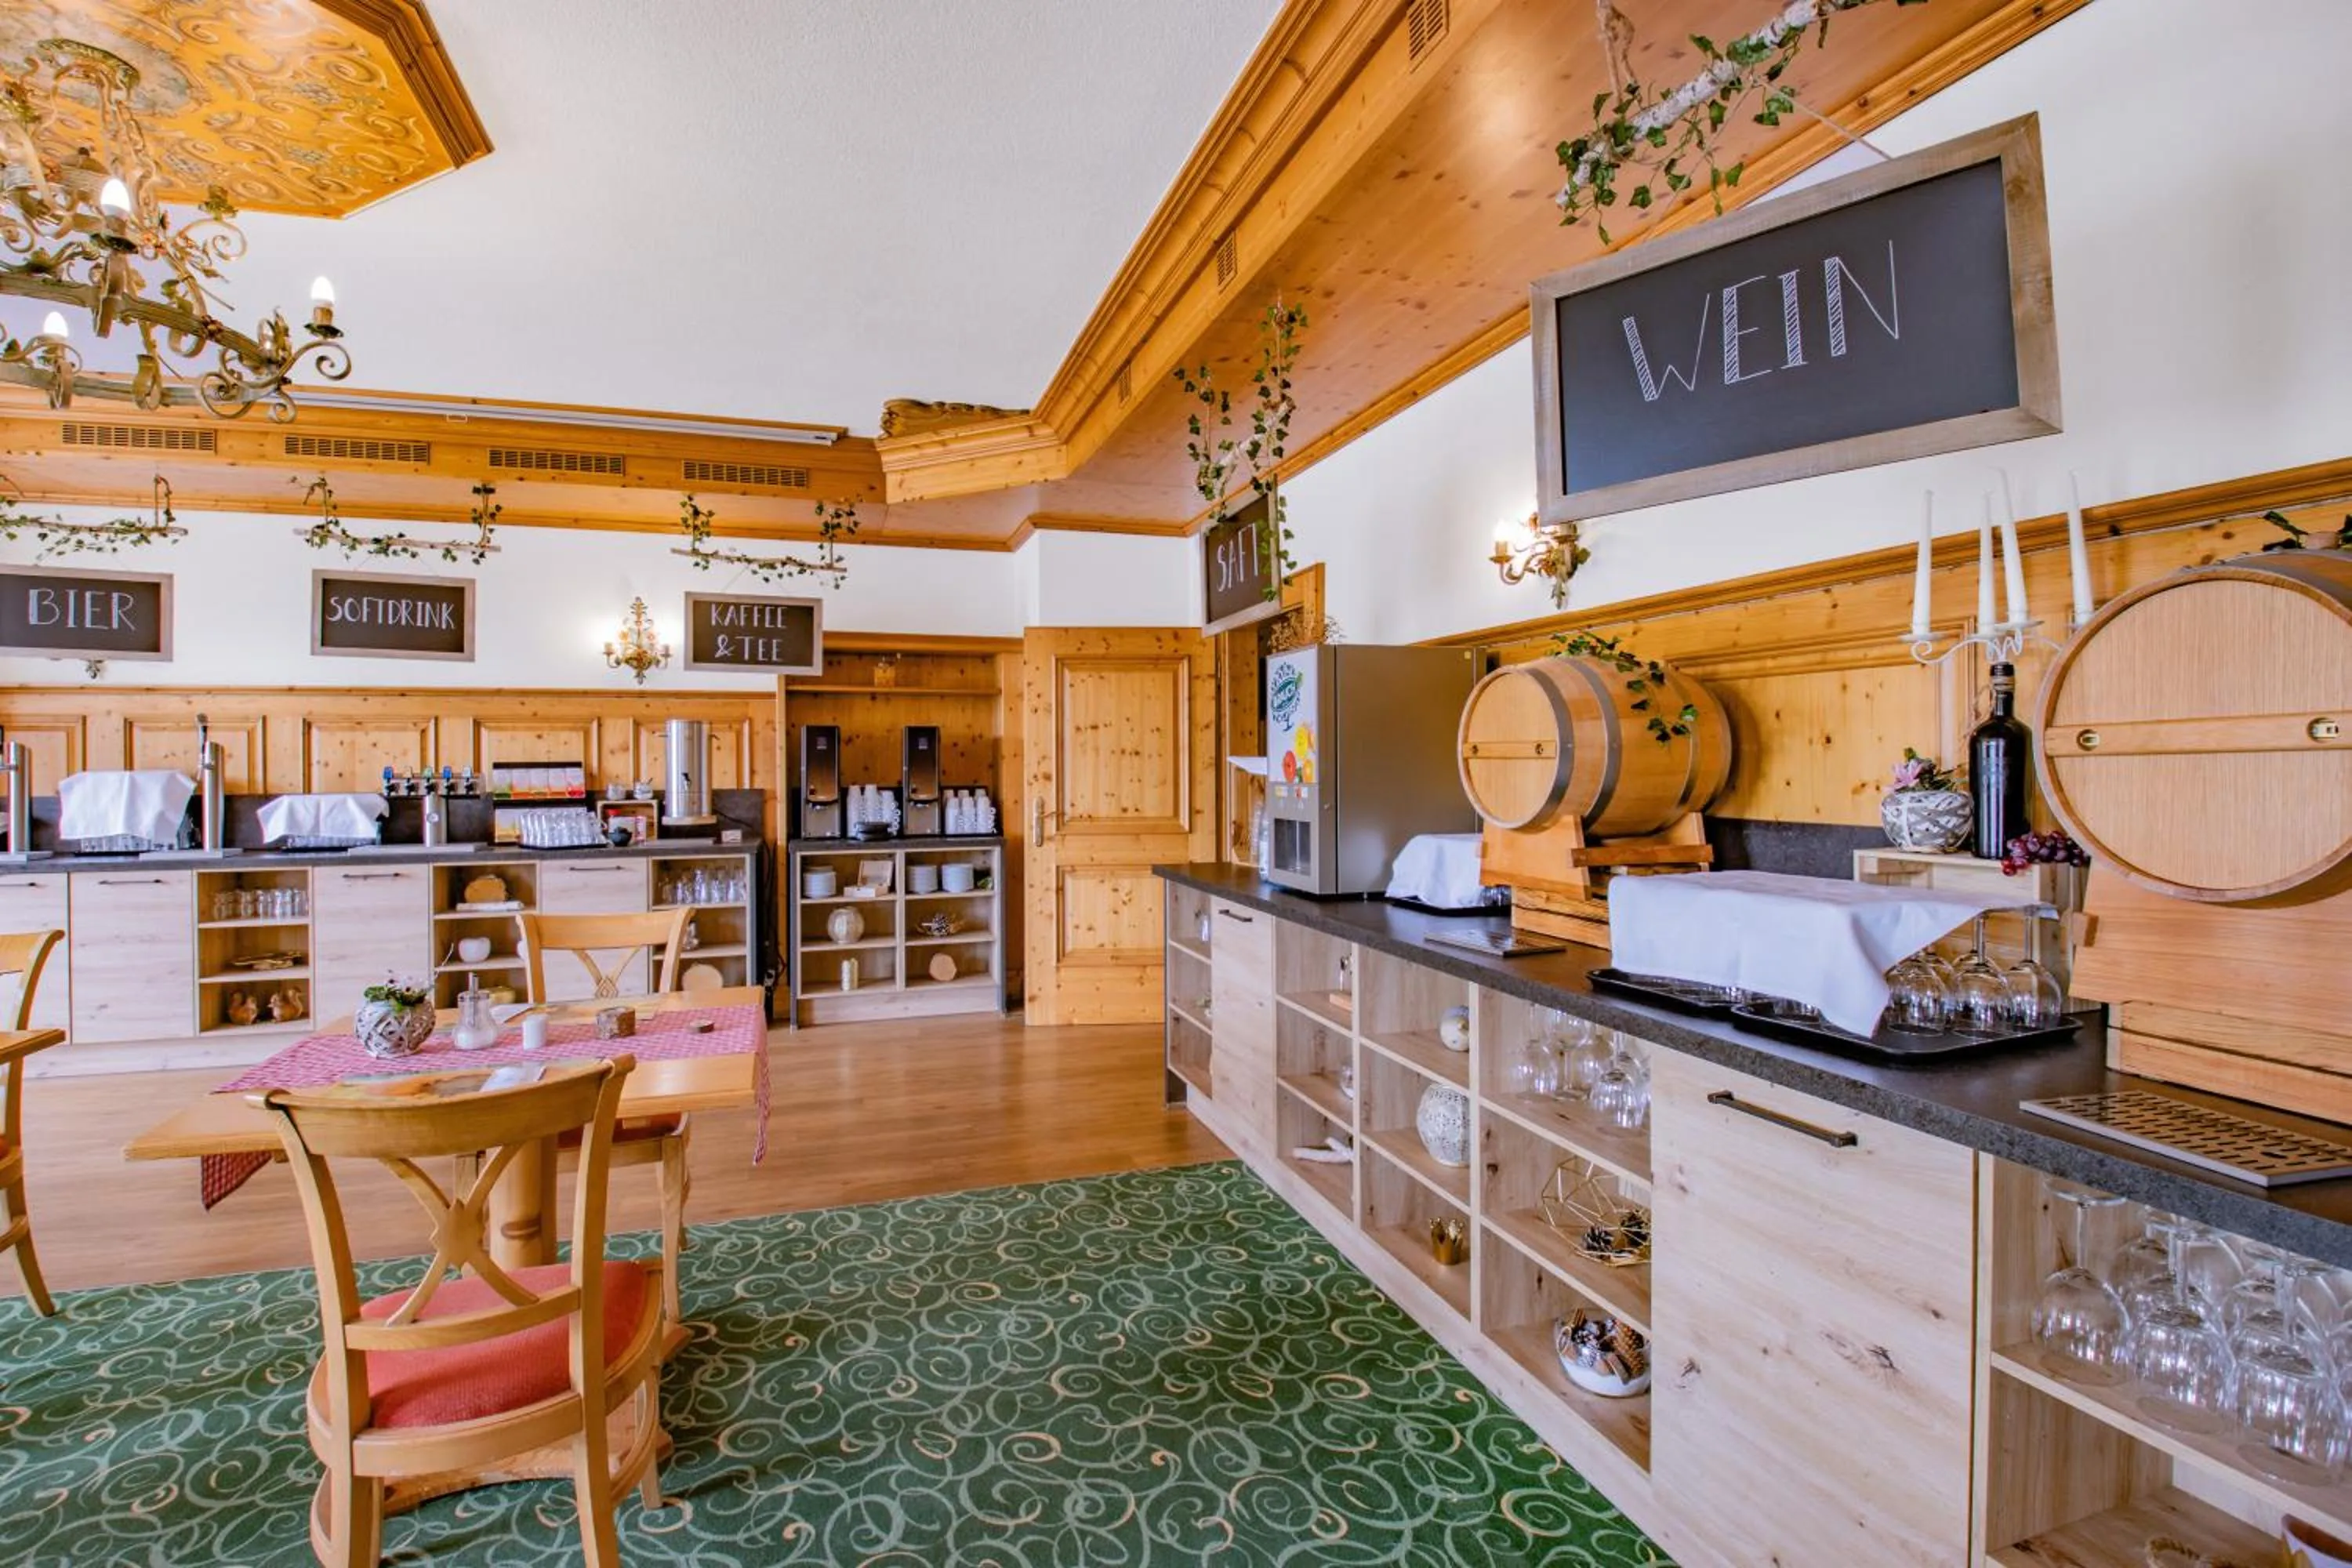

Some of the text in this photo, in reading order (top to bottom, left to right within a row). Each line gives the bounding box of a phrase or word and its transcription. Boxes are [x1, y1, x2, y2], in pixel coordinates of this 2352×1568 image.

[1622, 239, 1899, 401] WEIN
[1217, 522, 1258, 592] SAFT
[29, 588, 136, 631] BIER
[325, 597, 455, 630] SOFTDRINK
[711, 603, 788, 629] KAFFEE
[714, 633, 783, 661] & TEE
